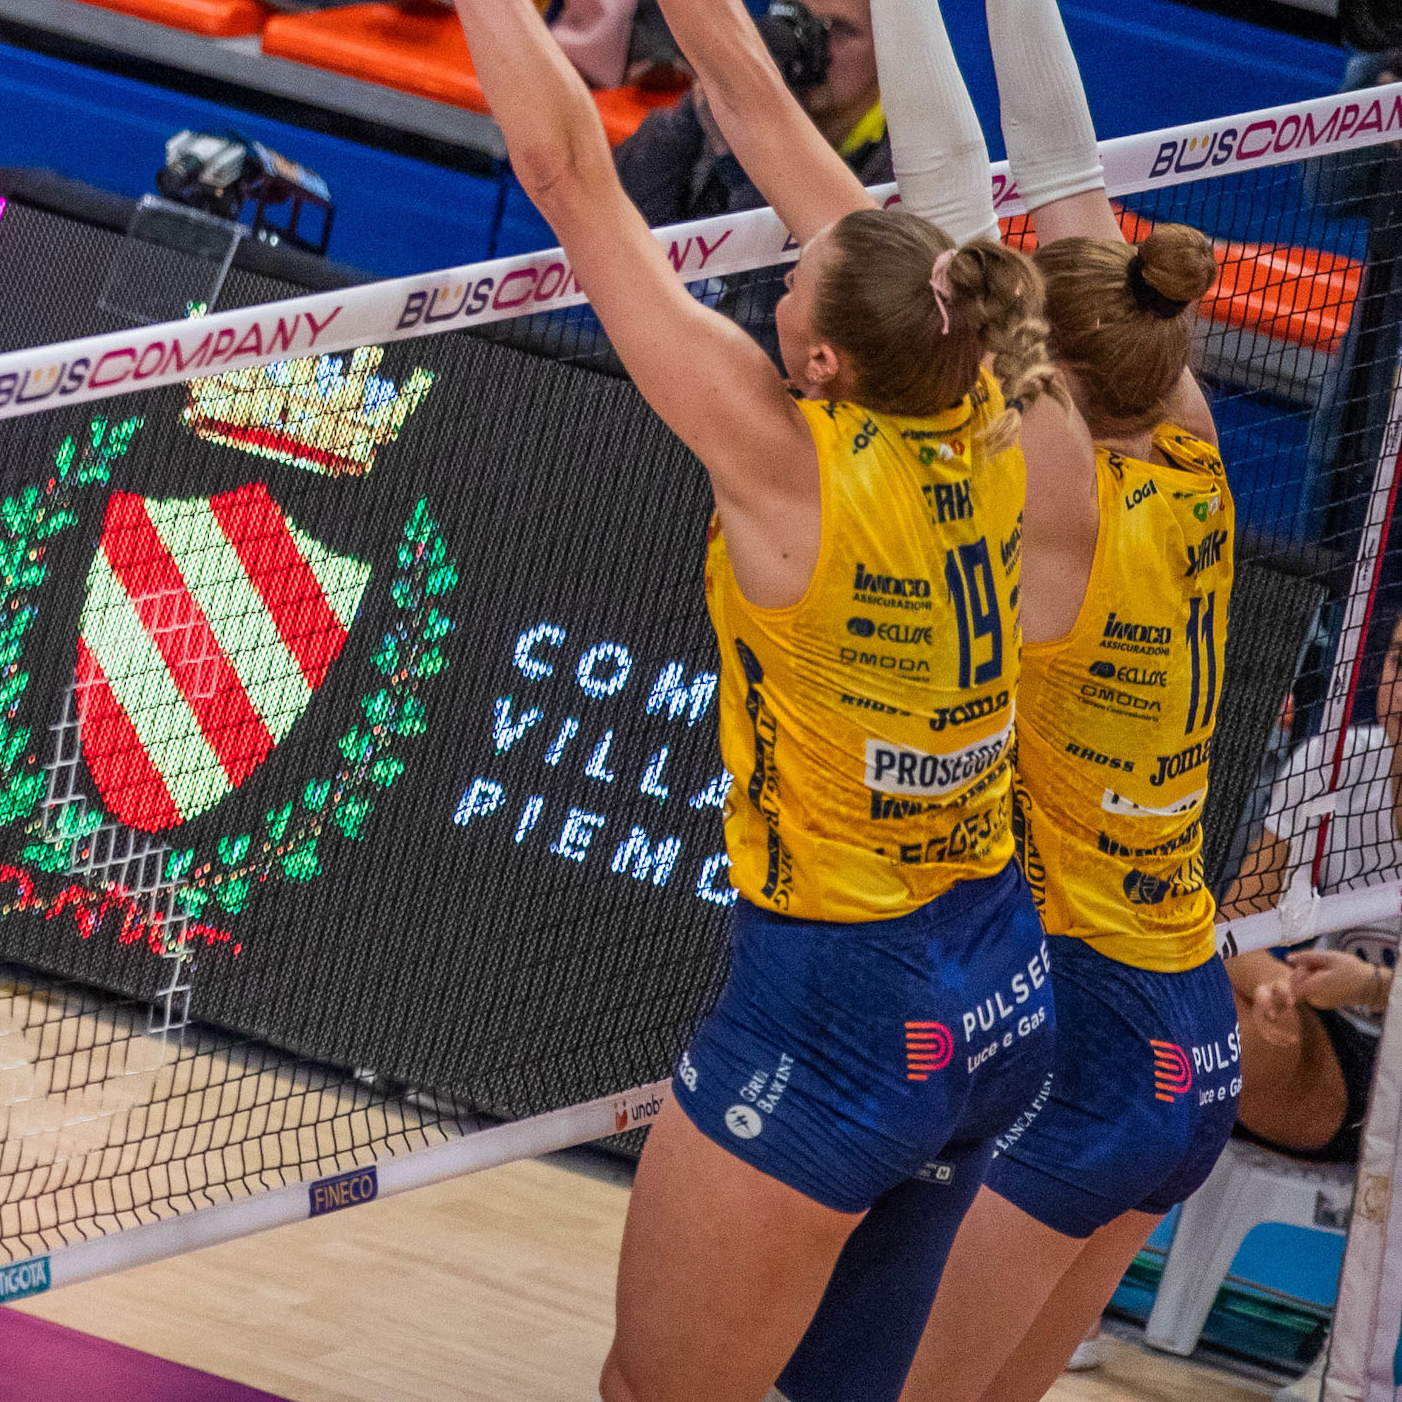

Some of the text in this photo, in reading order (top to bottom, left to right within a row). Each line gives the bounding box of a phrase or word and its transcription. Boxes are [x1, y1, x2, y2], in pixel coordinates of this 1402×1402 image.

[853, 592, 932, 610] ASSICURAZIONI
[945, 535, 1003, 689] 19
[839, 647, 930, 673] OMODA
[1099, 639, 1170, 657] ASSICURAZIONI
[1185, 590, 1216, 736] 11
[512, 622, 718, 728] COM
[929, 690, 1009, 731] Joma
[1080, 684, 1161, 713] OMODA
[493, 697, 734, 810] VILLA
[1066, 743, 1135, 773] RHOSS
[1150, 736, 1212, 787] Joma
[452, 777, 740, 907] PIEMO
[962, 941, 1052, 1043] PULSEE
[967, 1004, 1046, 1074] Luce e Gas
[631, 1094, 665, 1122] unob
[313, 1177, 374, 1212] FINECO
